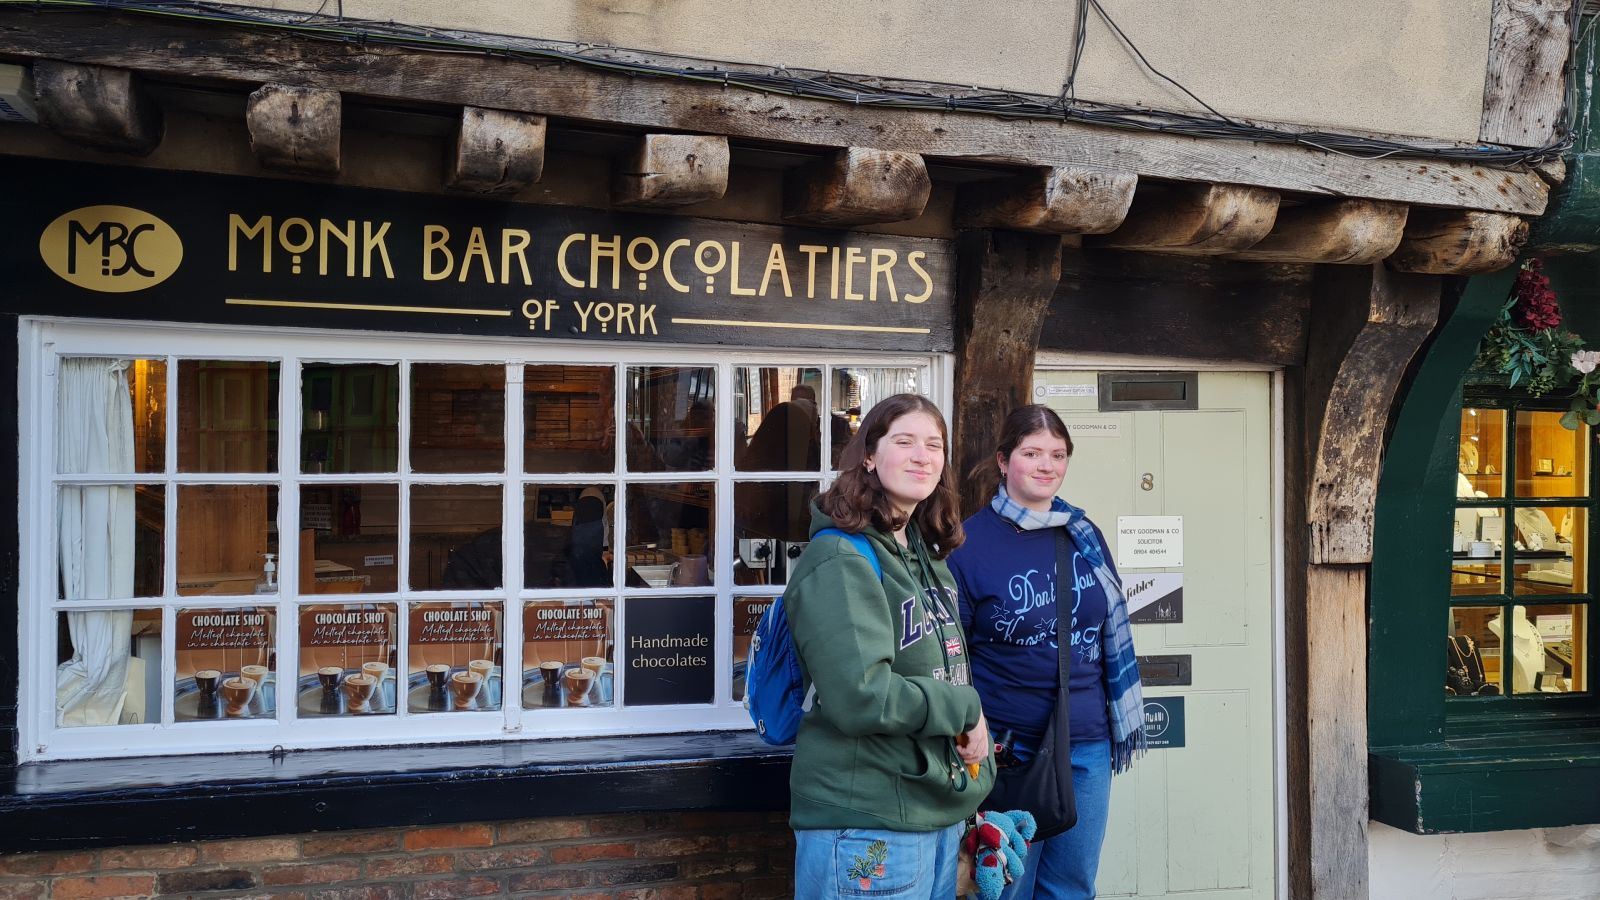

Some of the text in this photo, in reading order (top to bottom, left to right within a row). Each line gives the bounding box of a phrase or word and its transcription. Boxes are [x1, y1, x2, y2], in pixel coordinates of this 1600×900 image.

[67, 220, 156, 278] MBC
[227, 213, 934, 305] MONK BAR CHOCOLATIERS
[521, 298, 659, 336] OF YORK
[1140, 472, 1154, 492] 8
[1008, 569, 1056, 615] Don't
[1126, 578, 1155, 603] fabler
[191, 613, 266, 627] CHOCOLATE SHOT
[314, 612, 386, 625] CHOCOLATE SHOT
[423, 610, 492, 622] CHOCOLATE SHOT
[536, 608, 604, 620] CHOCOLATE SHOT
[190, 626, 267, 642] Melted chocolate
[313, 623, 387, 639] Melted chocolate
[422, 621, 493, 637] Melted chocolate
[535, 619, 605, 635] Melted chocolate
[553, 628, 591, 640] chocolate
[209, 636, 251, 648] chocolate
[332, 633, 372, 645] chocolate
[439, 632, 479, 643] chocolate
[630, 633, 709, 649] Handmade
[631, 652, 707, 669] chocolates
